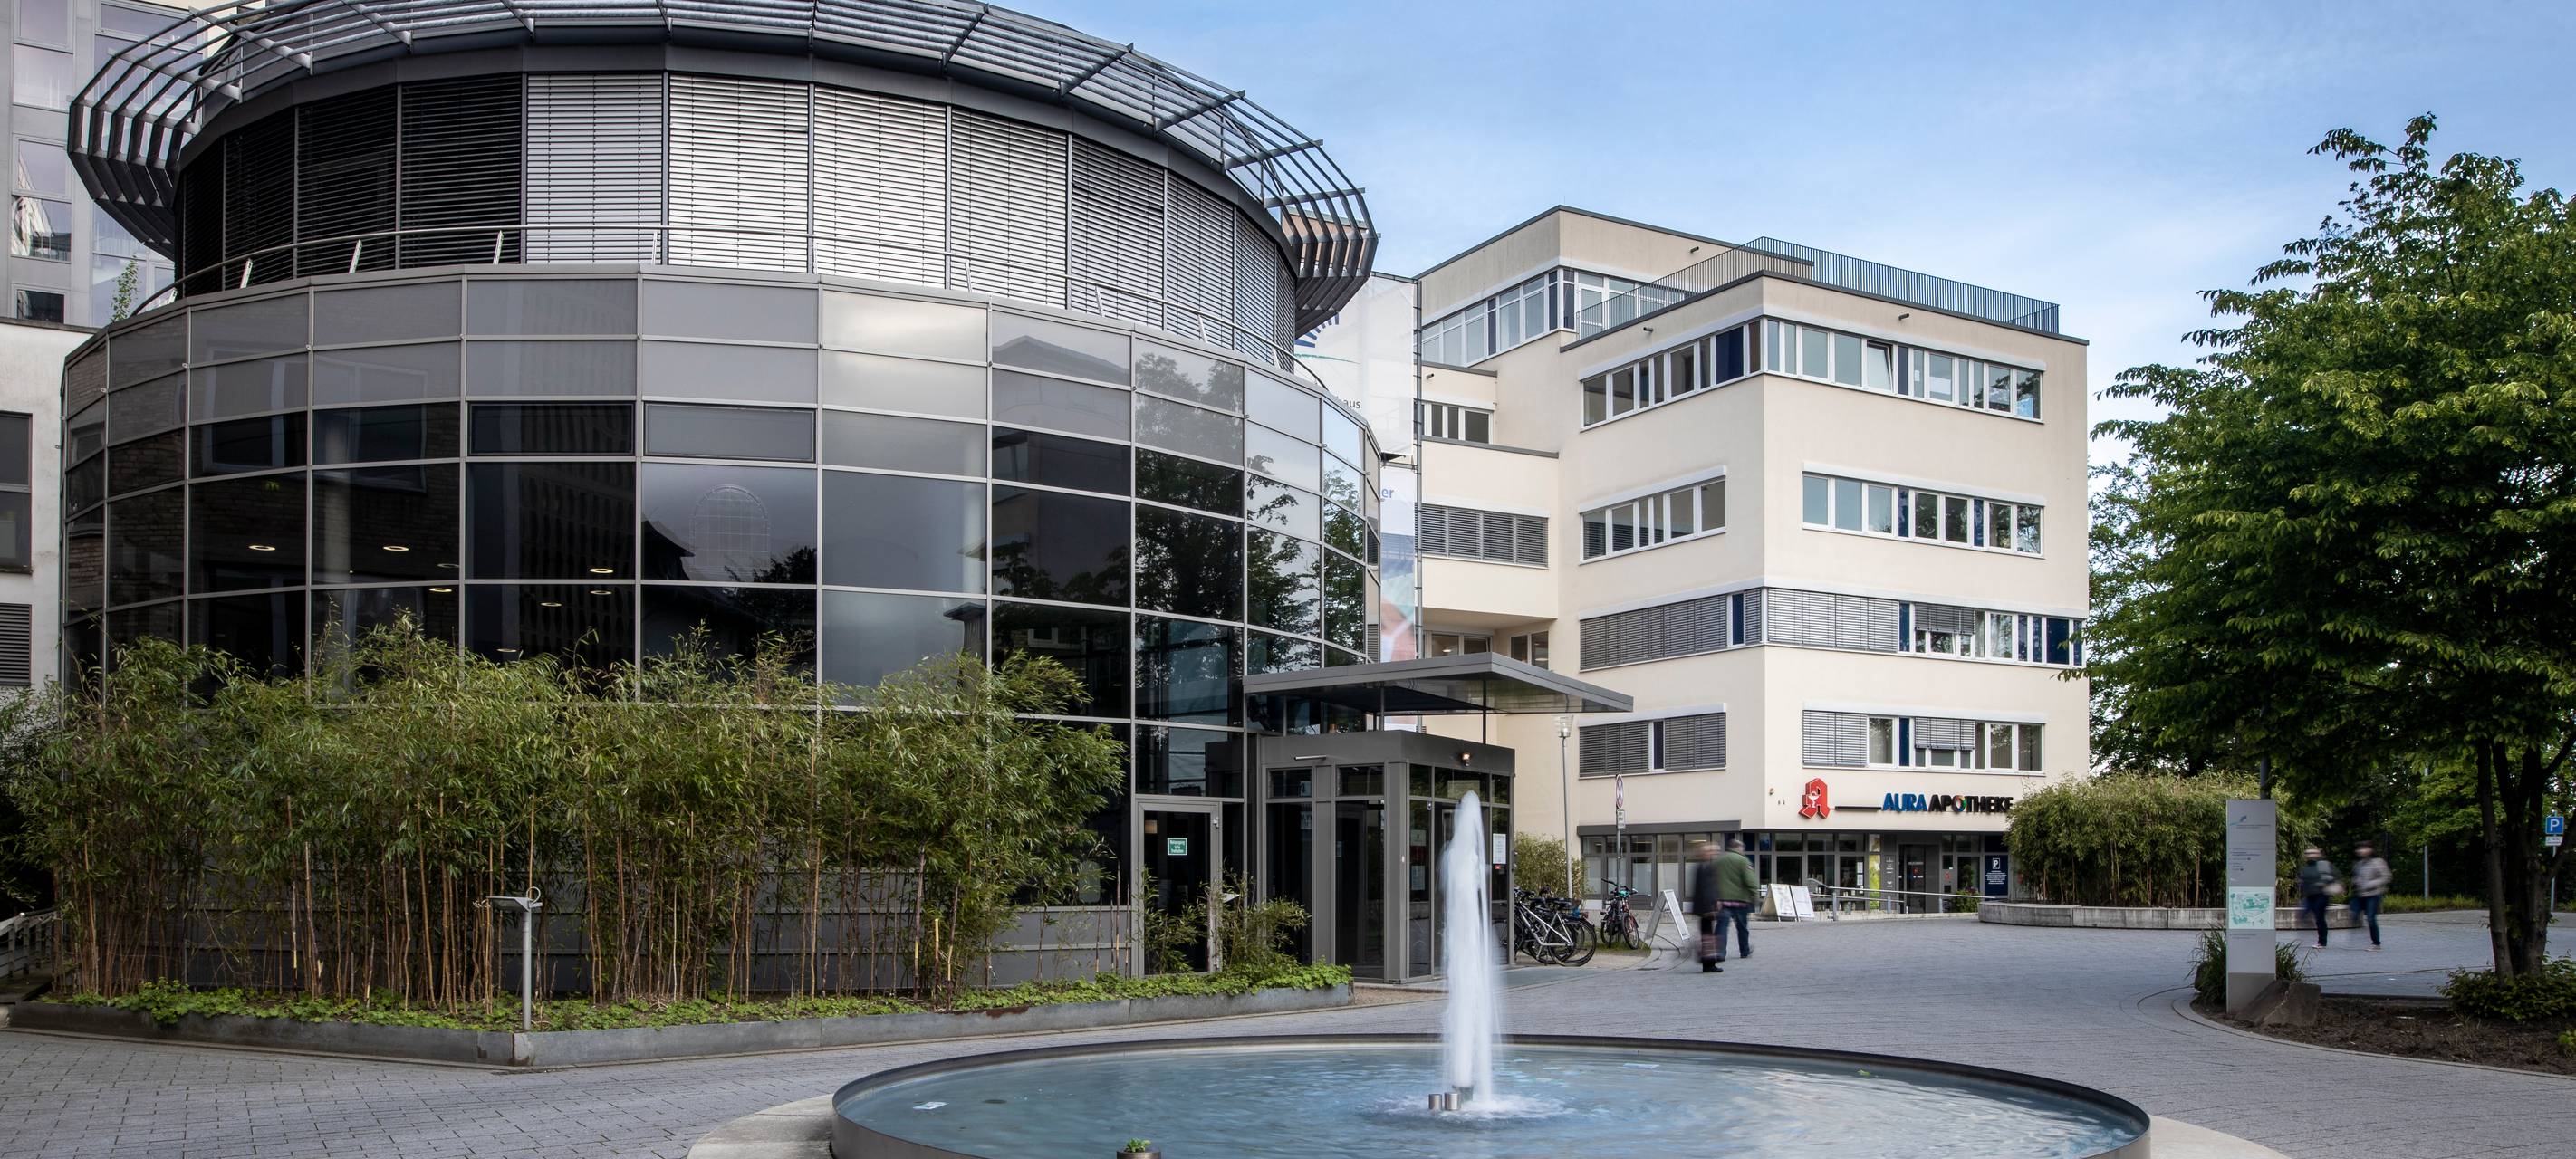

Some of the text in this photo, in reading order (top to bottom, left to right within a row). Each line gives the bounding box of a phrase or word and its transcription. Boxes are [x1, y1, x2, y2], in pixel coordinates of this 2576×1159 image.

[1883, 793, 2014, 812] AURA APOTHEKE
[2550, 819, 2560, 832] P
